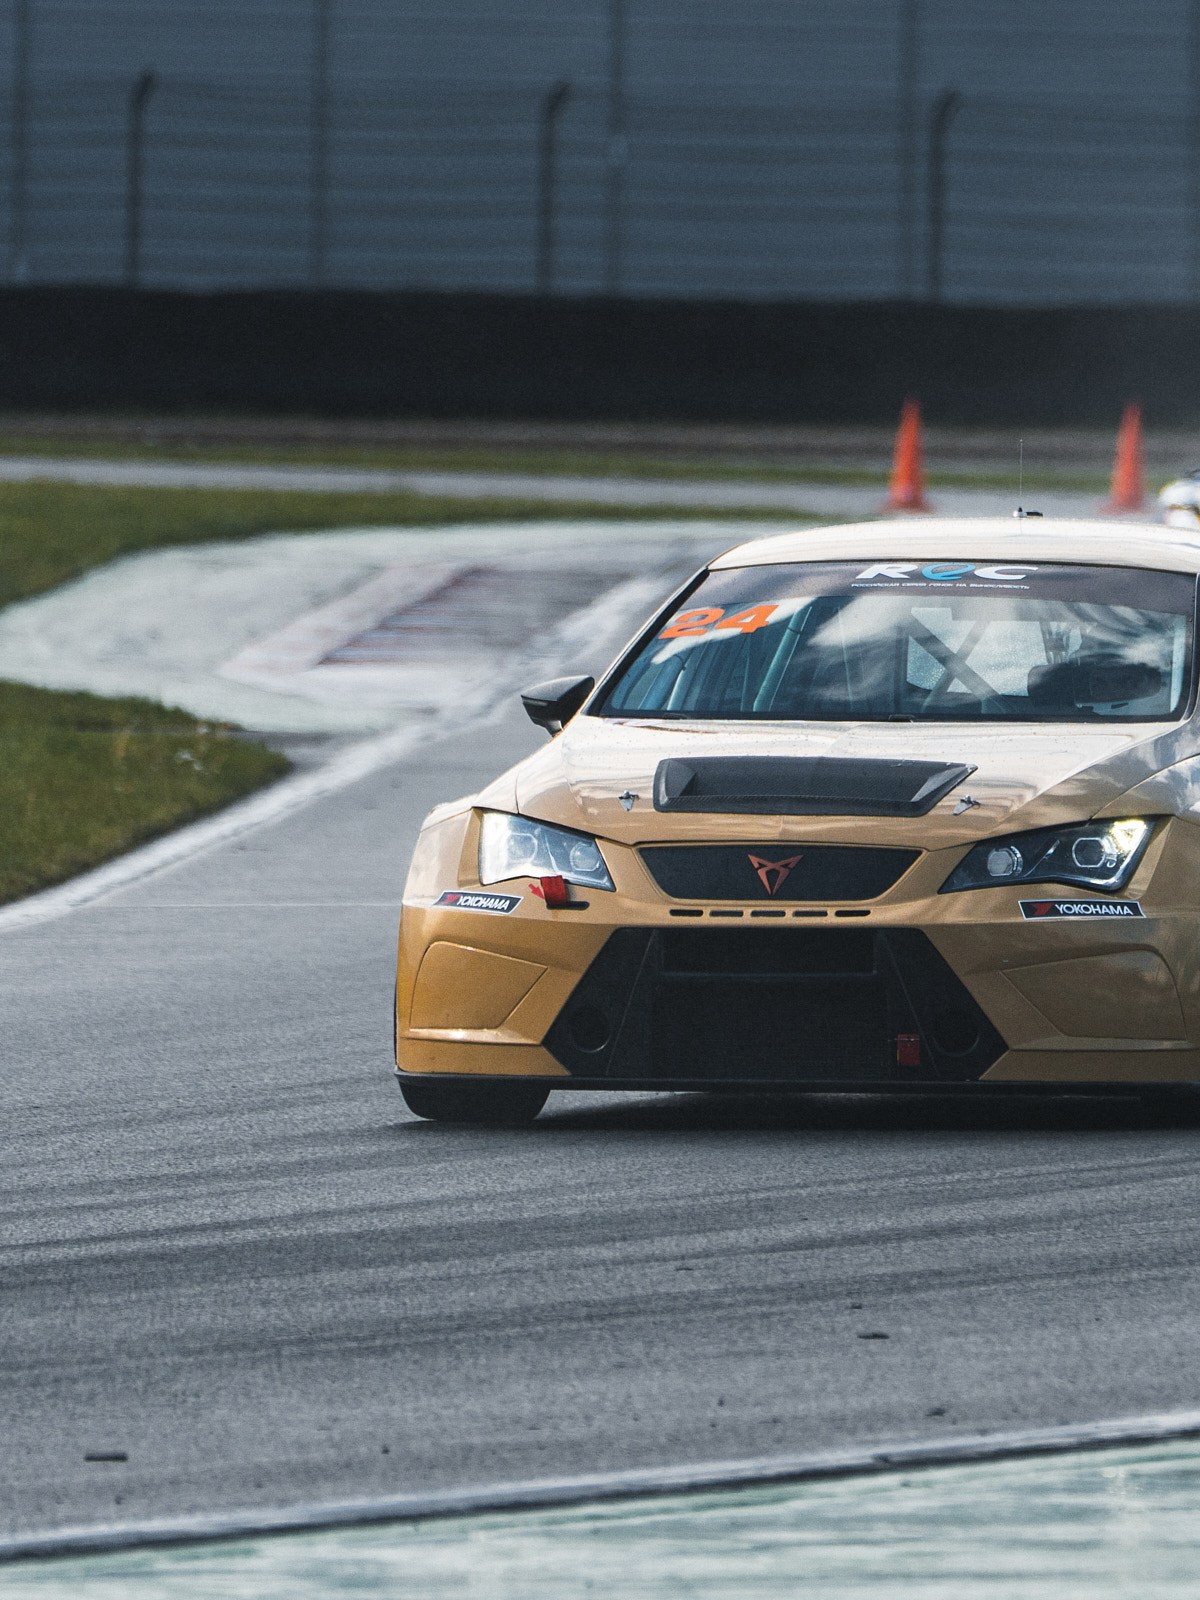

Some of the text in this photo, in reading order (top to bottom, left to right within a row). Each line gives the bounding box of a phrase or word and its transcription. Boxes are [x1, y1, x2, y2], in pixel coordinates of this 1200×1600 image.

[658, 604, 779, 639] 24
[456, 896, 511, 911] YOKOHAMA
[1055, 903, 1134, 916] YOKOHAMA
